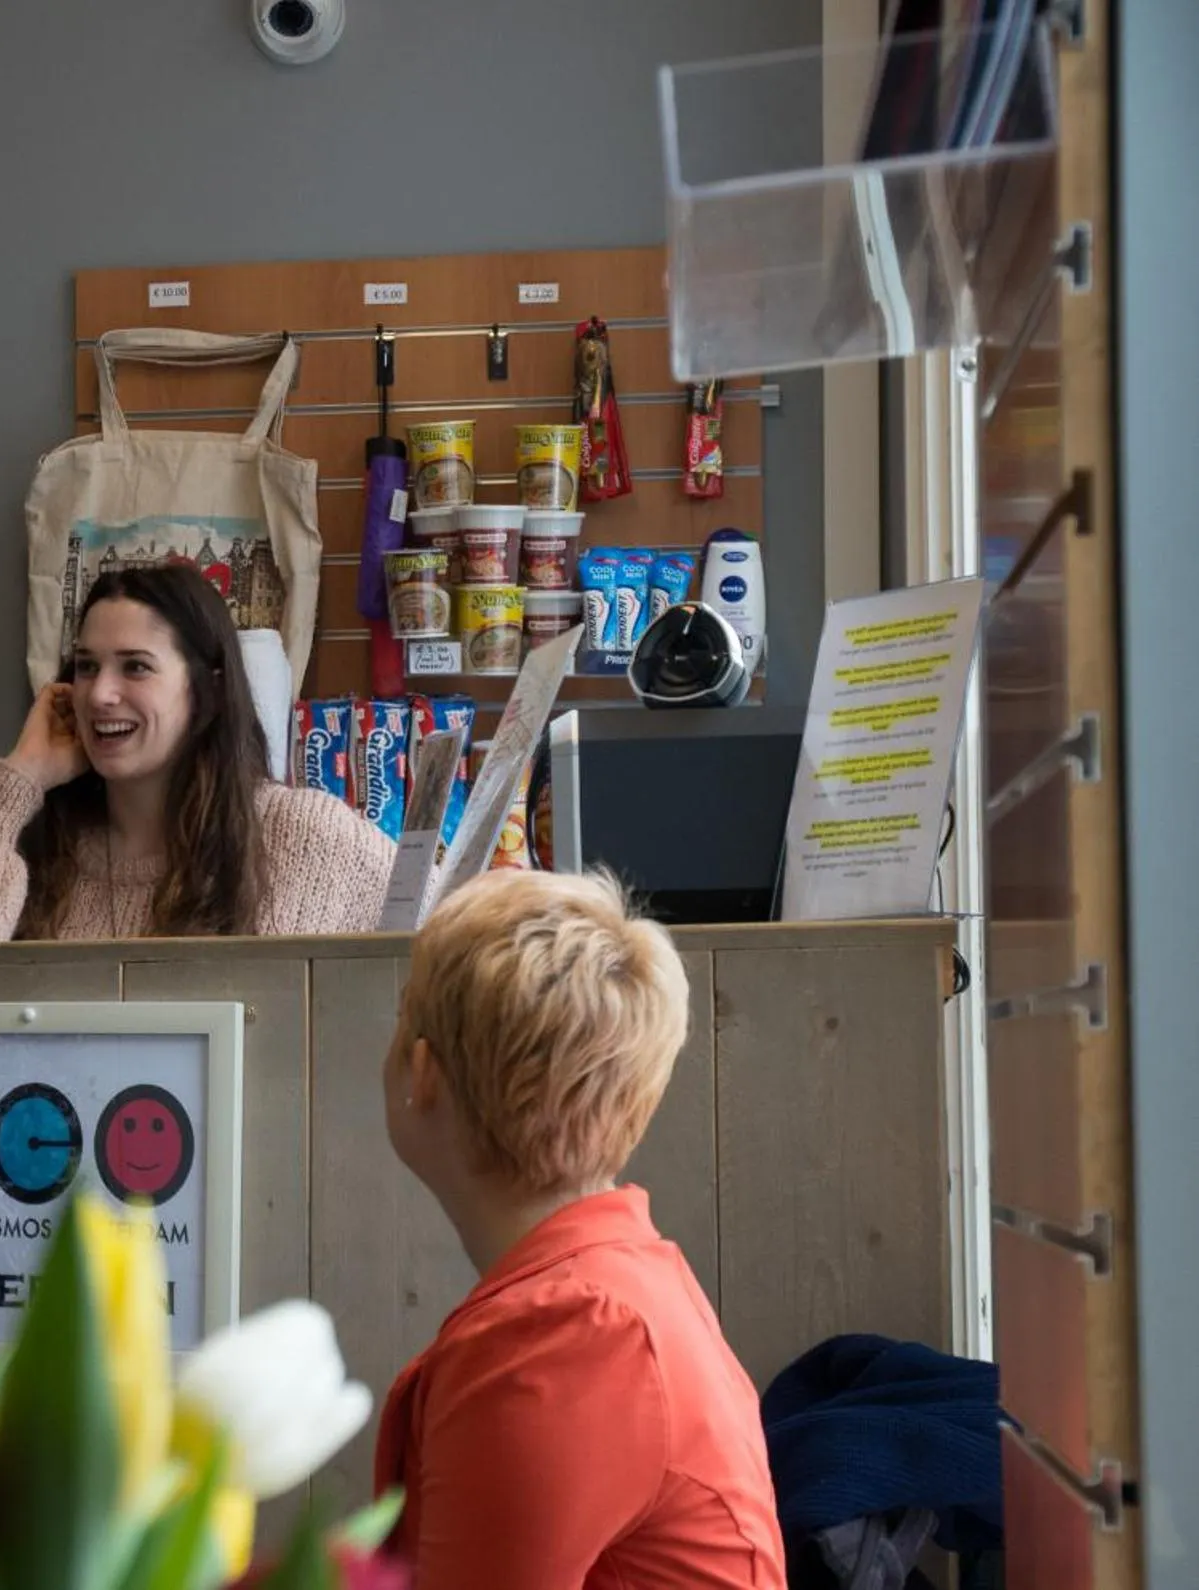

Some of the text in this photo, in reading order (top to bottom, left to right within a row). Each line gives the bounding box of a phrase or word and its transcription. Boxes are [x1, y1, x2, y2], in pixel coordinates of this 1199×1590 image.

[689, 416, 701, 466] Colgate
[589, 565, 616, 575] COOL
[622, 564, 647, 574] COOL
[661, 566, 685, 578] COOL
[720, 585, 745, 594] NIVEA
[617, 593, 629, 650] PRODENT
[366, 730, 393, 822] Grandino
